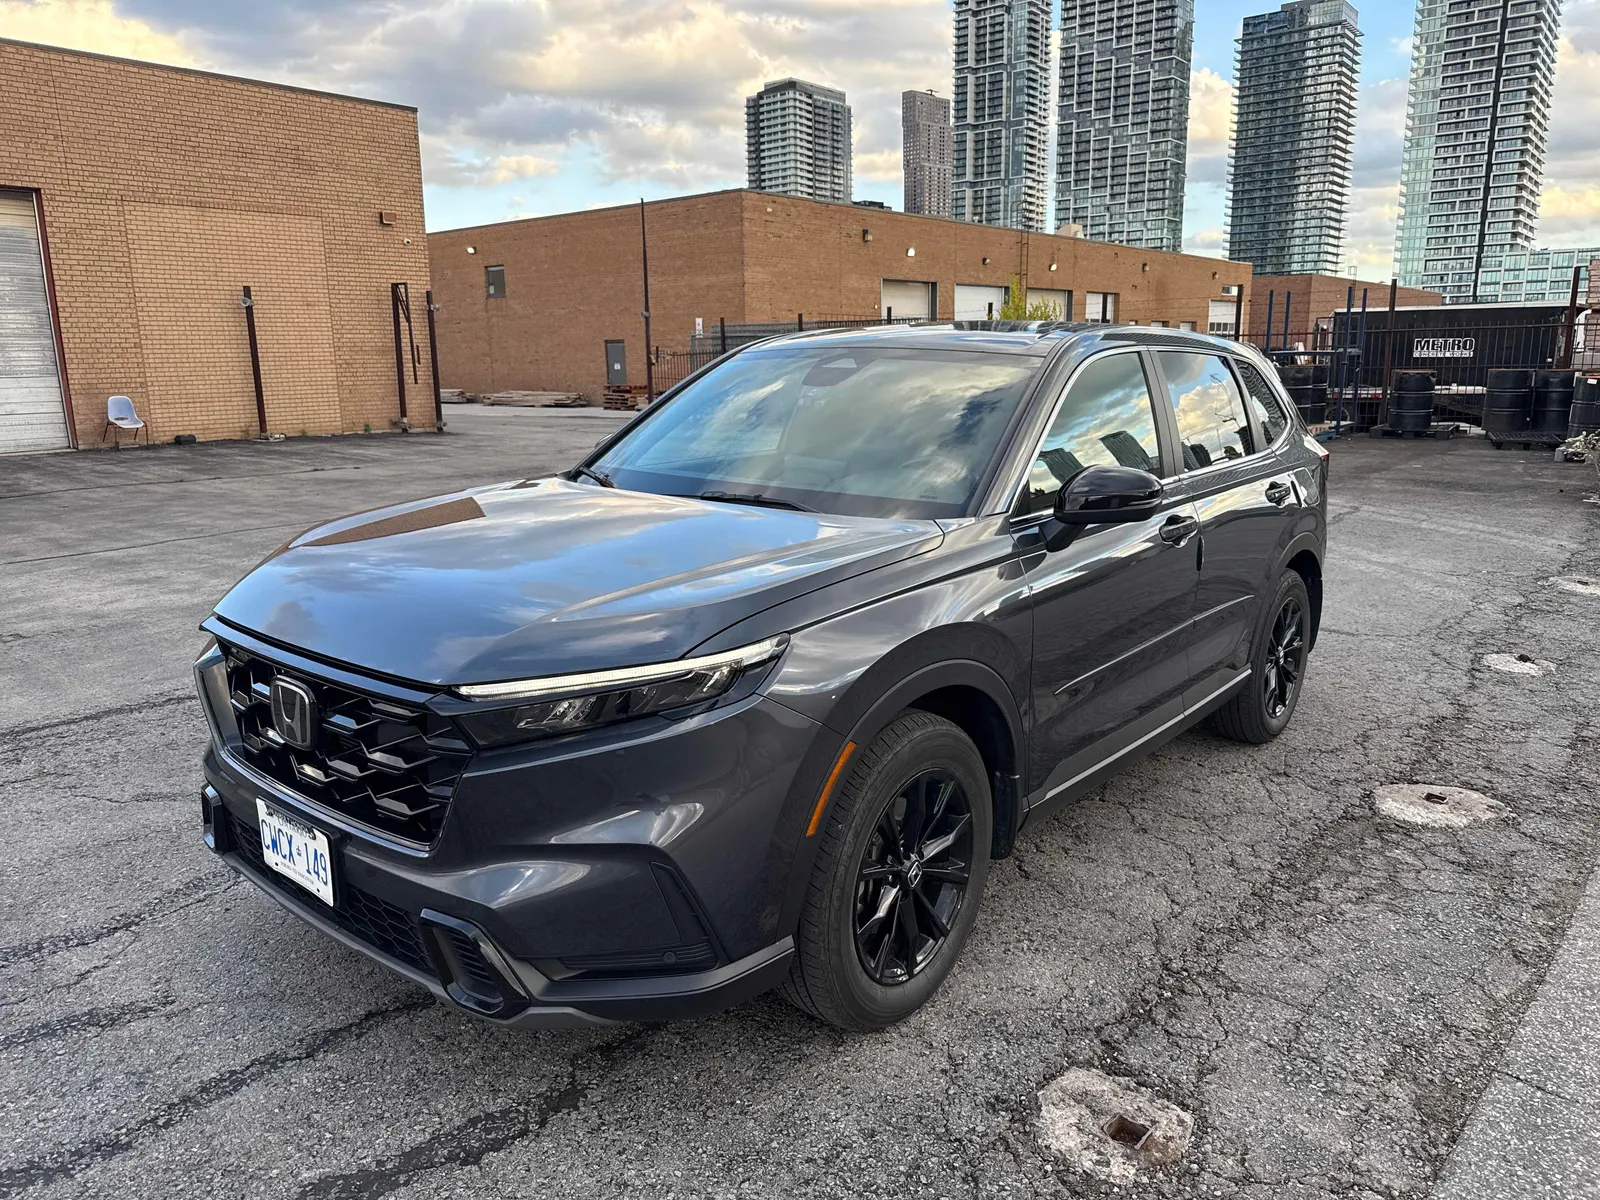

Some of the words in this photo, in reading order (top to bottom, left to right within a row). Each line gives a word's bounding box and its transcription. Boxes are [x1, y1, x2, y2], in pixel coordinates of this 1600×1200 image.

[1413, 338, 1475, 352] METRO
[261, 819, 296, 866] CWCX
[304, 843, 328, 886] 149
